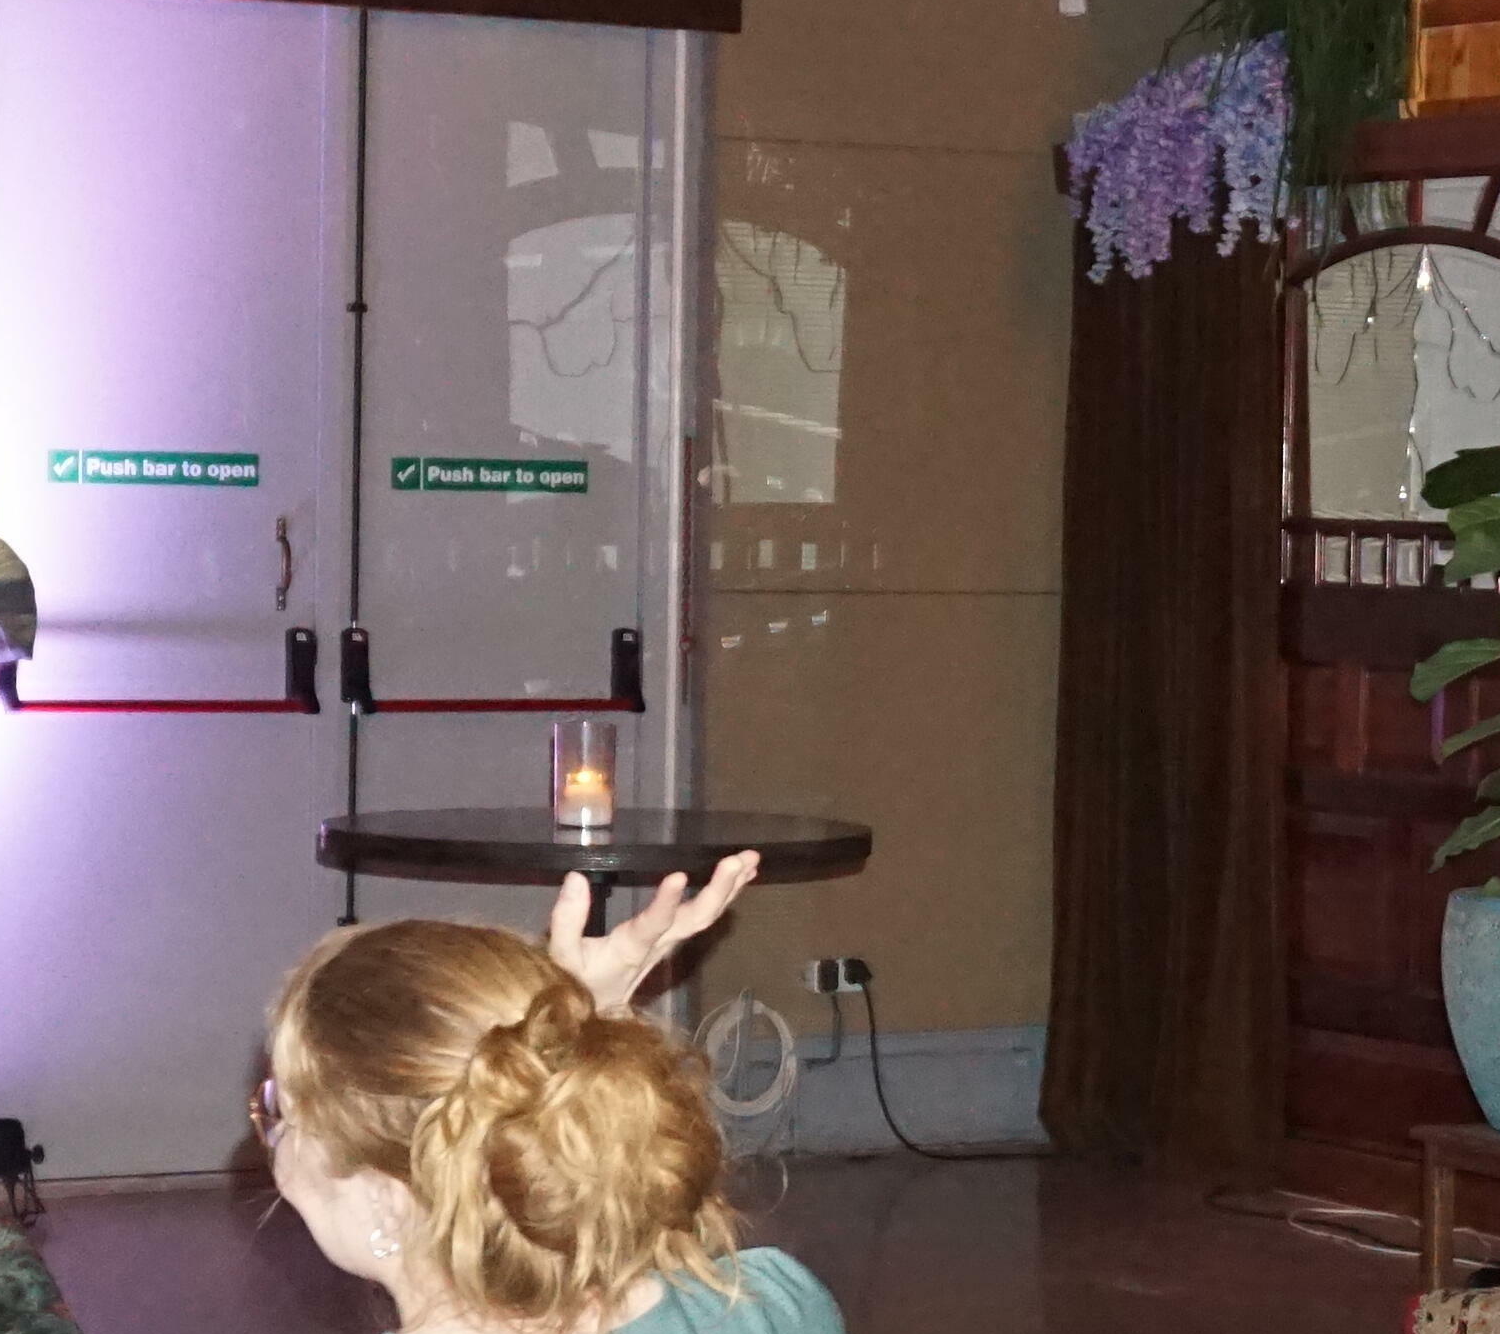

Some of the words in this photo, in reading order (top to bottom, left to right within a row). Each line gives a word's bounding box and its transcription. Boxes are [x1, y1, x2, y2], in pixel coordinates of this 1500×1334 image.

[85, 457, 137, 477] Push
[142, 458, 177, 478] bar
[181, 460, 202, 478] to
[206, 463, 256, 481] open
[427, 465, 475, 484] Push
[479, 466, 512, 484] bar
[515, 468, 535, 484] to
[539, 470, 585, 488] open
